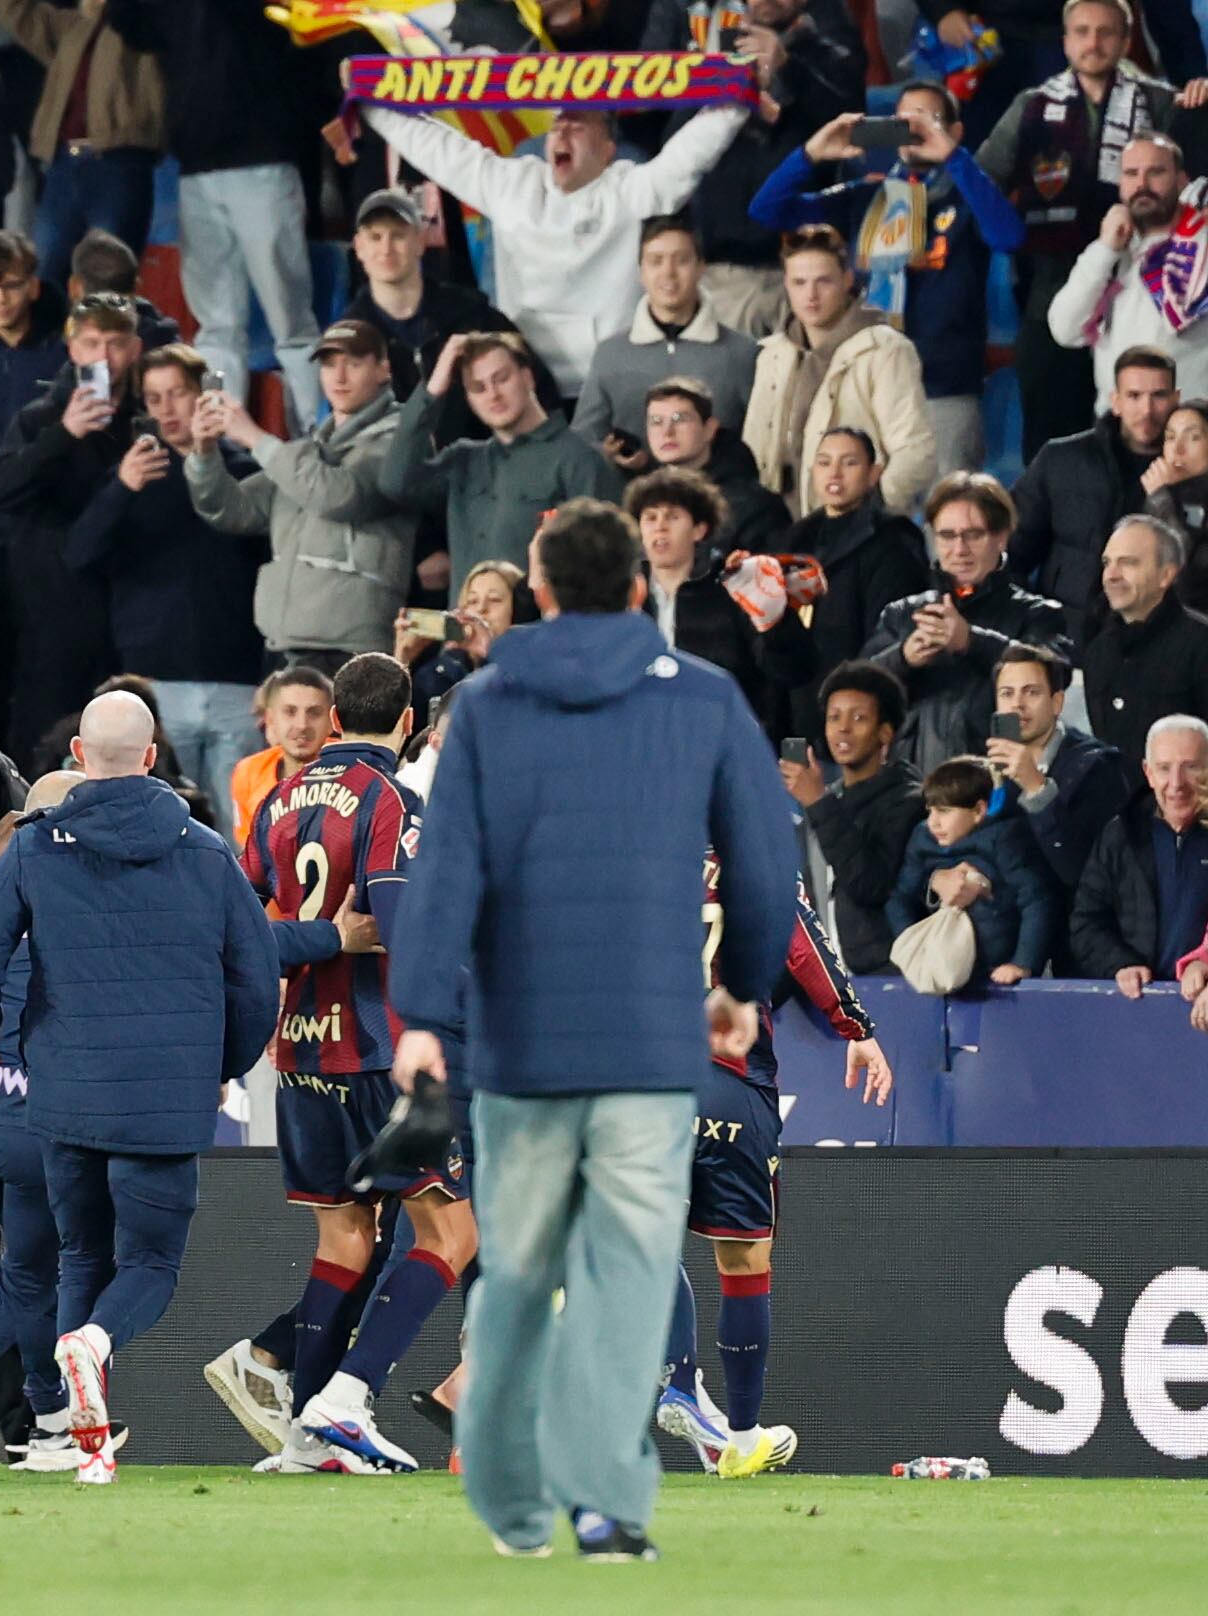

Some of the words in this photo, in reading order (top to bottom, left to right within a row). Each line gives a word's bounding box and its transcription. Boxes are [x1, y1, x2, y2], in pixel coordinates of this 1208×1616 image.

[373, 58, 493, 102] ANTI
[505, 53, 705, 99] CHOTOS
[295, 841, 329, 922] 2
[998, 1264, 1208, 1460] se
